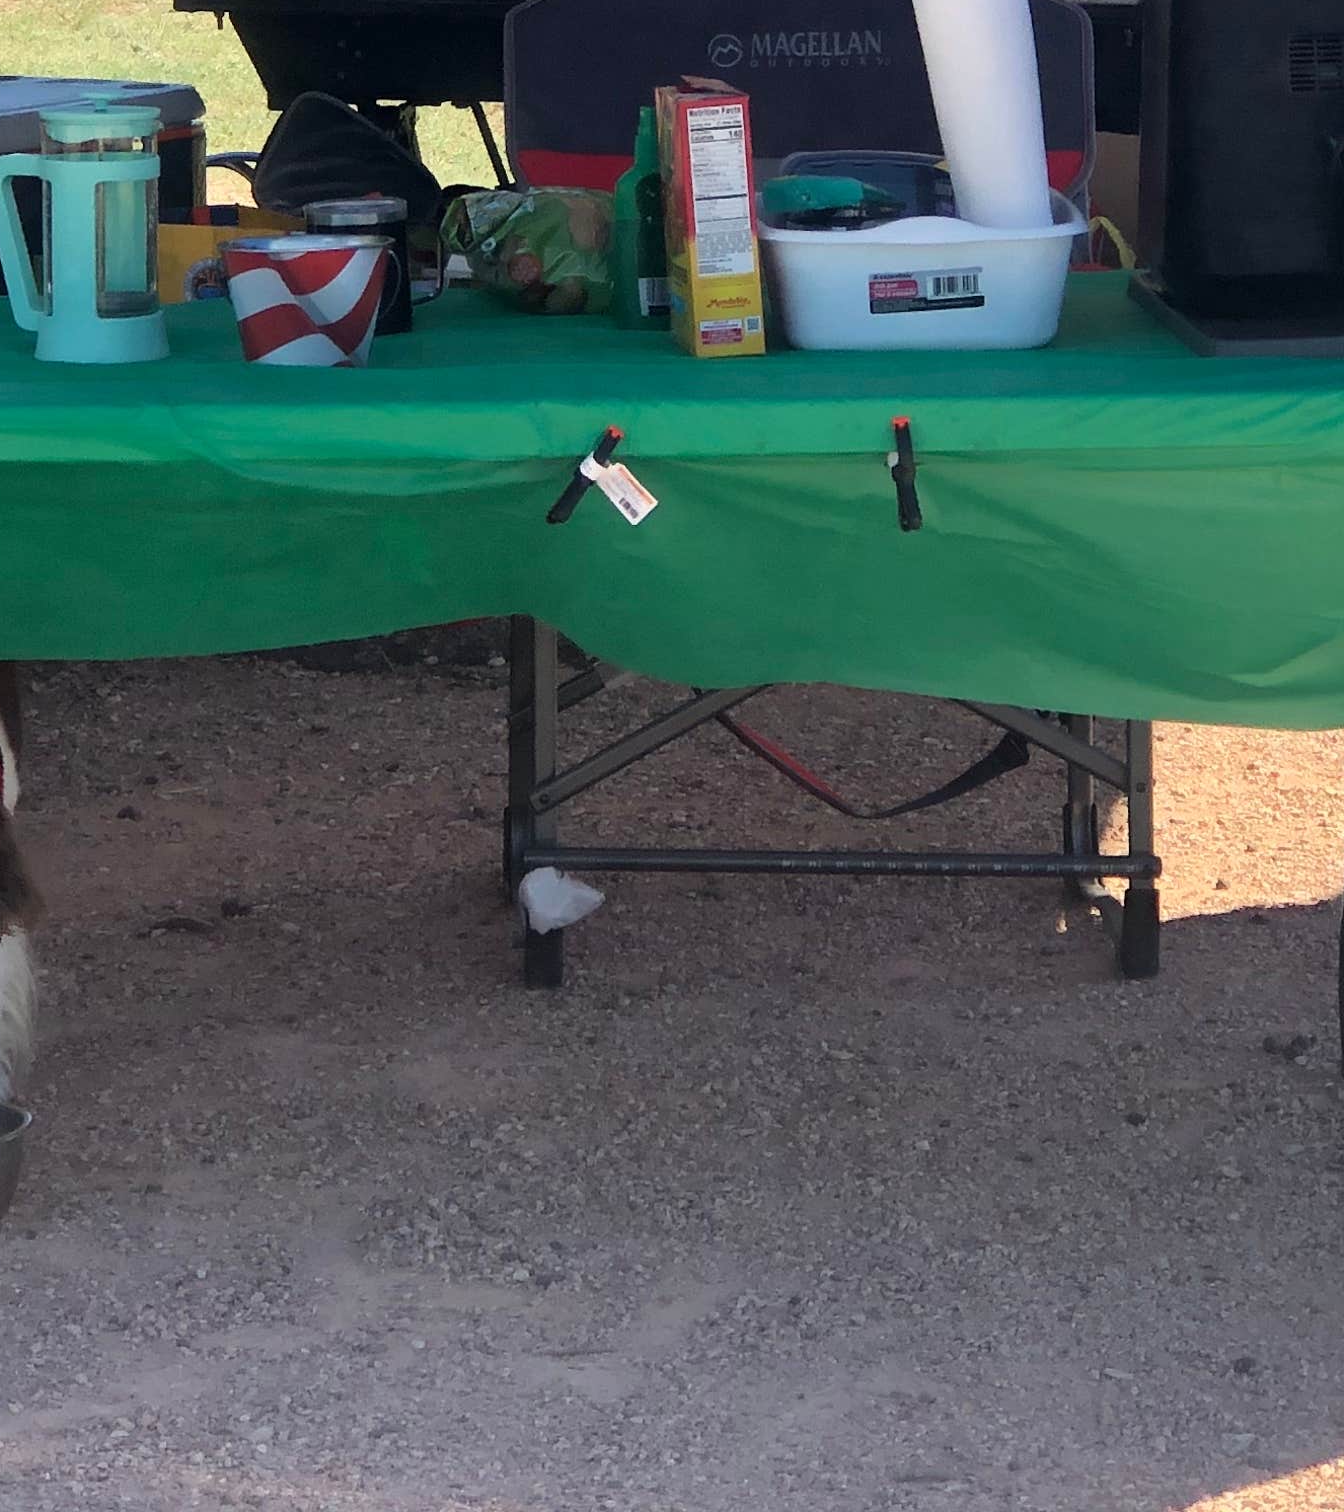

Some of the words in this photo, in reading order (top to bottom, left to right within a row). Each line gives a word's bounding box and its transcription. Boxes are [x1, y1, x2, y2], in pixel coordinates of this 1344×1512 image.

[751, 30, 882, 57] MAGELLAN
[689, 109, 720, 117] Nutrition
[721, 106, 741, 115] Facts
